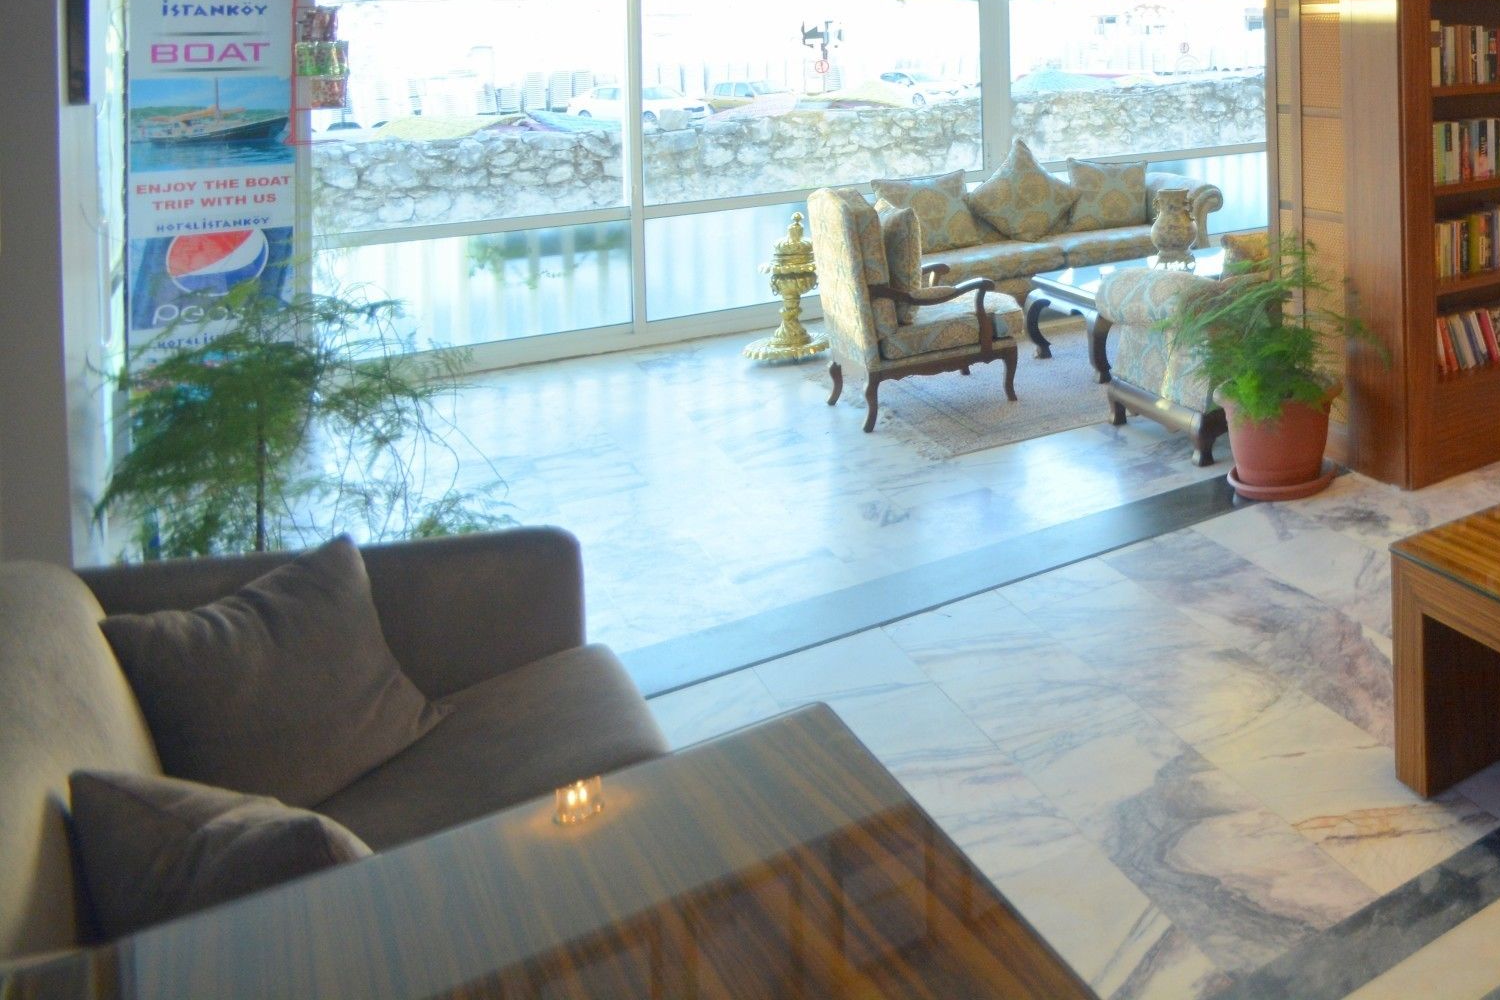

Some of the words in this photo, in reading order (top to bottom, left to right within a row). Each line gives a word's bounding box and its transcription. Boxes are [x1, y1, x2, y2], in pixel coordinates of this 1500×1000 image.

[151, 42, 270, 63] BOAT
[136, 181, 197, 195] ENJOY
[203, 178, 240, 190] THE
[245, 175, 291, 188] BOAT
[152, 198, 195, 211] TRIP
[200, 195, 247, 208] WITH
[253, 193, 277, 204] US
[156, 222, 198, 233] HOTEL
